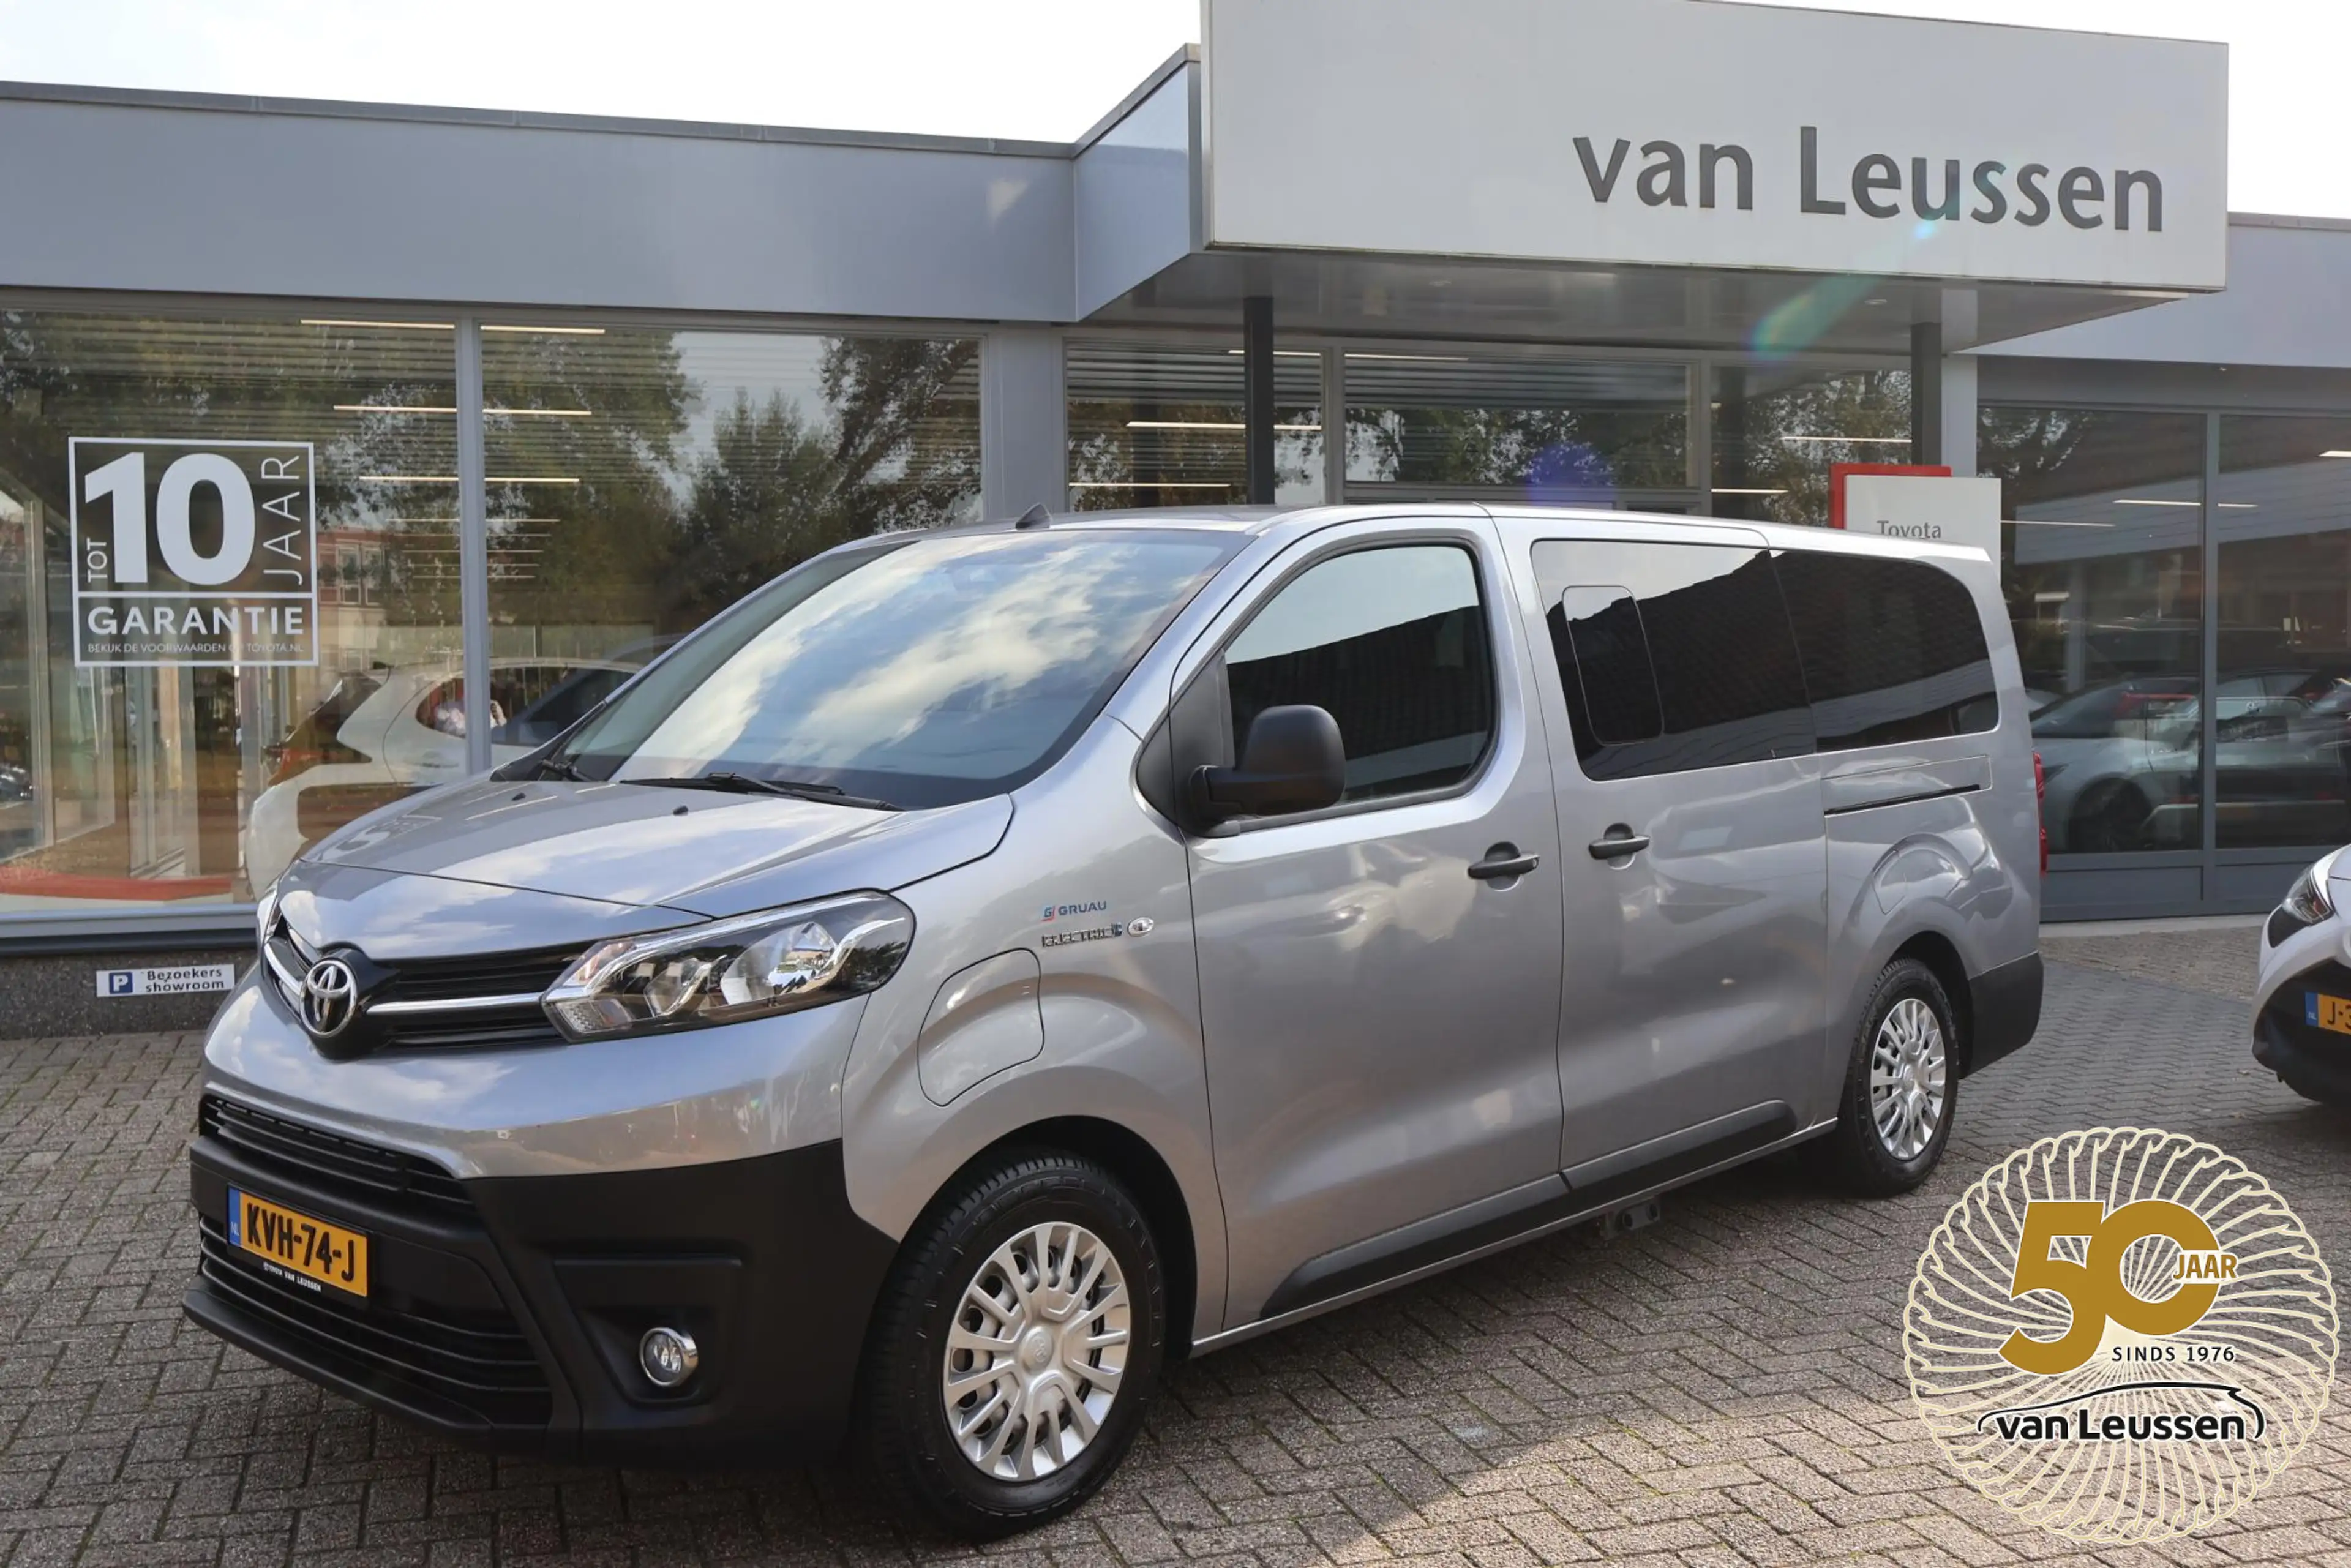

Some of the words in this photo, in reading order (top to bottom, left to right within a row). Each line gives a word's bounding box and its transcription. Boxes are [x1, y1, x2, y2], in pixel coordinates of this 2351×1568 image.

[1572, 136, 1753, 210] van
[1800, 126, 2162, 232] Leussen
[84, 452, 255, 585] 10
[261, 455, 303, 585] JAAR
[86, 537, 108, 583] TOT
[87, 606, 304, 636] GARANTIE
[88, 643, 122, 653] BEKIJK
[124, 643, 138, 653] DE
[141, 643, 227, 653] VOORWAARDEN
[246, 643, 304, 653] TOYOTA.NL
[1058, 901, 1107, 916] GRUAU
[113, 975, 129, 992] P
[147, 968, 222, 981] Bezoekers
[146, 981, 224, 992] showroom
[230, 1221, 240, 1236] NL
[247, 1202, 354, 1283] KVH-74-J
